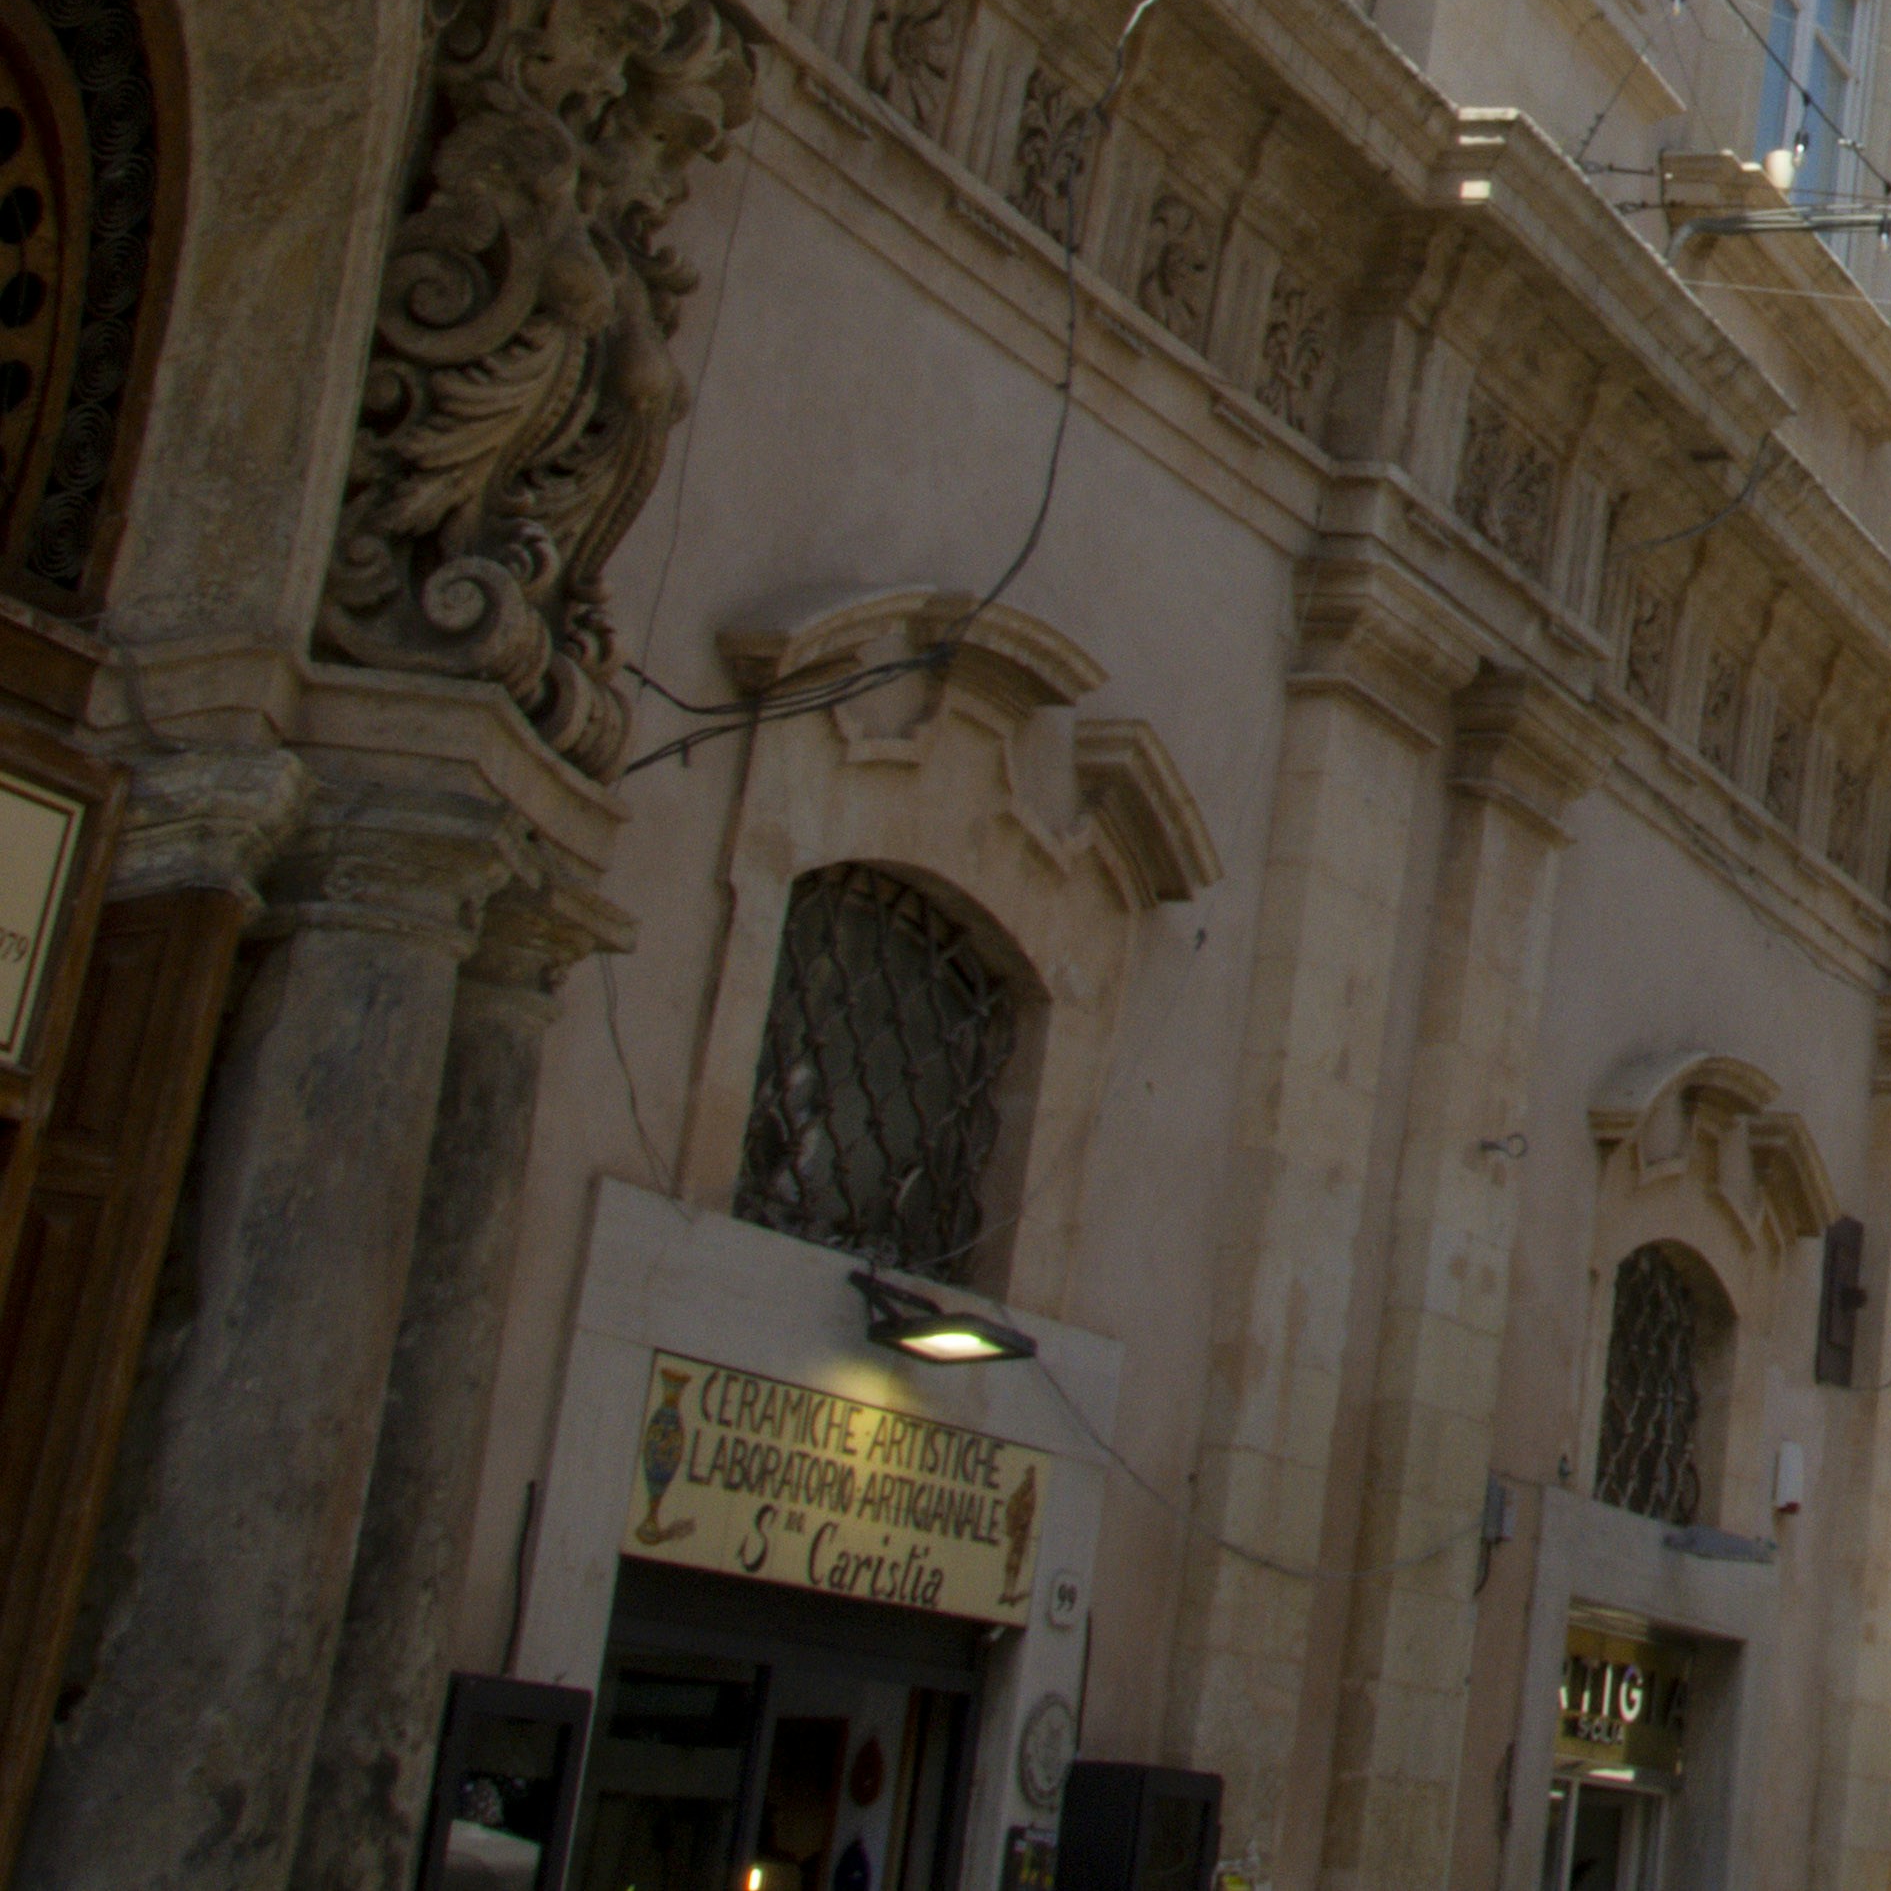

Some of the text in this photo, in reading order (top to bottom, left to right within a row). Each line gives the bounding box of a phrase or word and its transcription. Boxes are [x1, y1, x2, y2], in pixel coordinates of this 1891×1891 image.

[701, 1369, 1006, 1490] CERAMICHE ARTISTICHE
[686, 1429, 1005, 1547] LABORATORIO ARTIGIANALE
[808, 1521, 946, 1608] Caristia
[1057, 1583, 1078, 1613] 99
